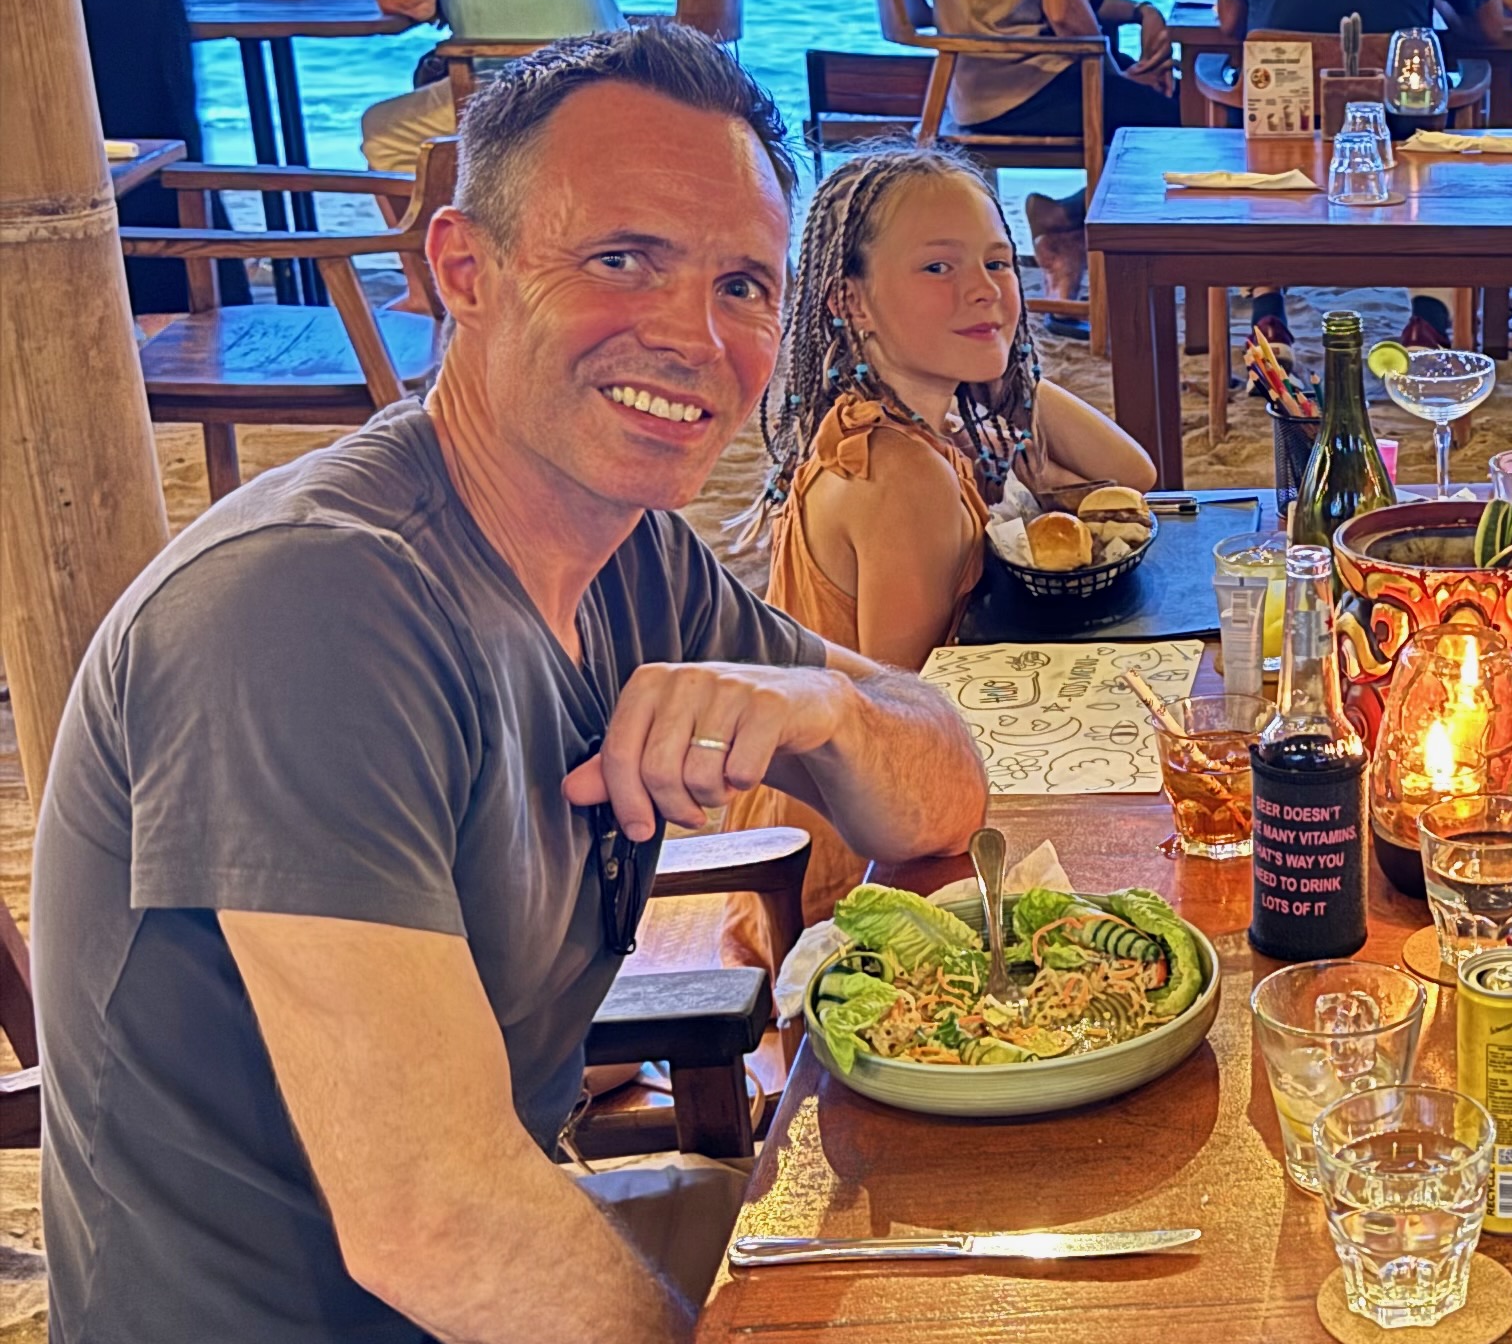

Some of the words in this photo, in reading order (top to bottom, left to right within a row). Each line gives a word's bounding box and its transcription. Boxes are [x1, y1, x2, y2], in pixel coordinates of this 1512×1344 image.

[1284, 806, 1341, 822] DOESN'T
[1264, 824, 1296, 844] MANY
[1286, 853, 1316, 869] WAY
[1318, 852, 1344, 869] YOU
[1280, 876, 1298, 892] TO
[1300, 876, 1342, 893] DRINK
[1262, 892, 1290, 914] LOTS
[1292, 902, 1312, 916] OF
[1314, 902, 1327, 916] IT
